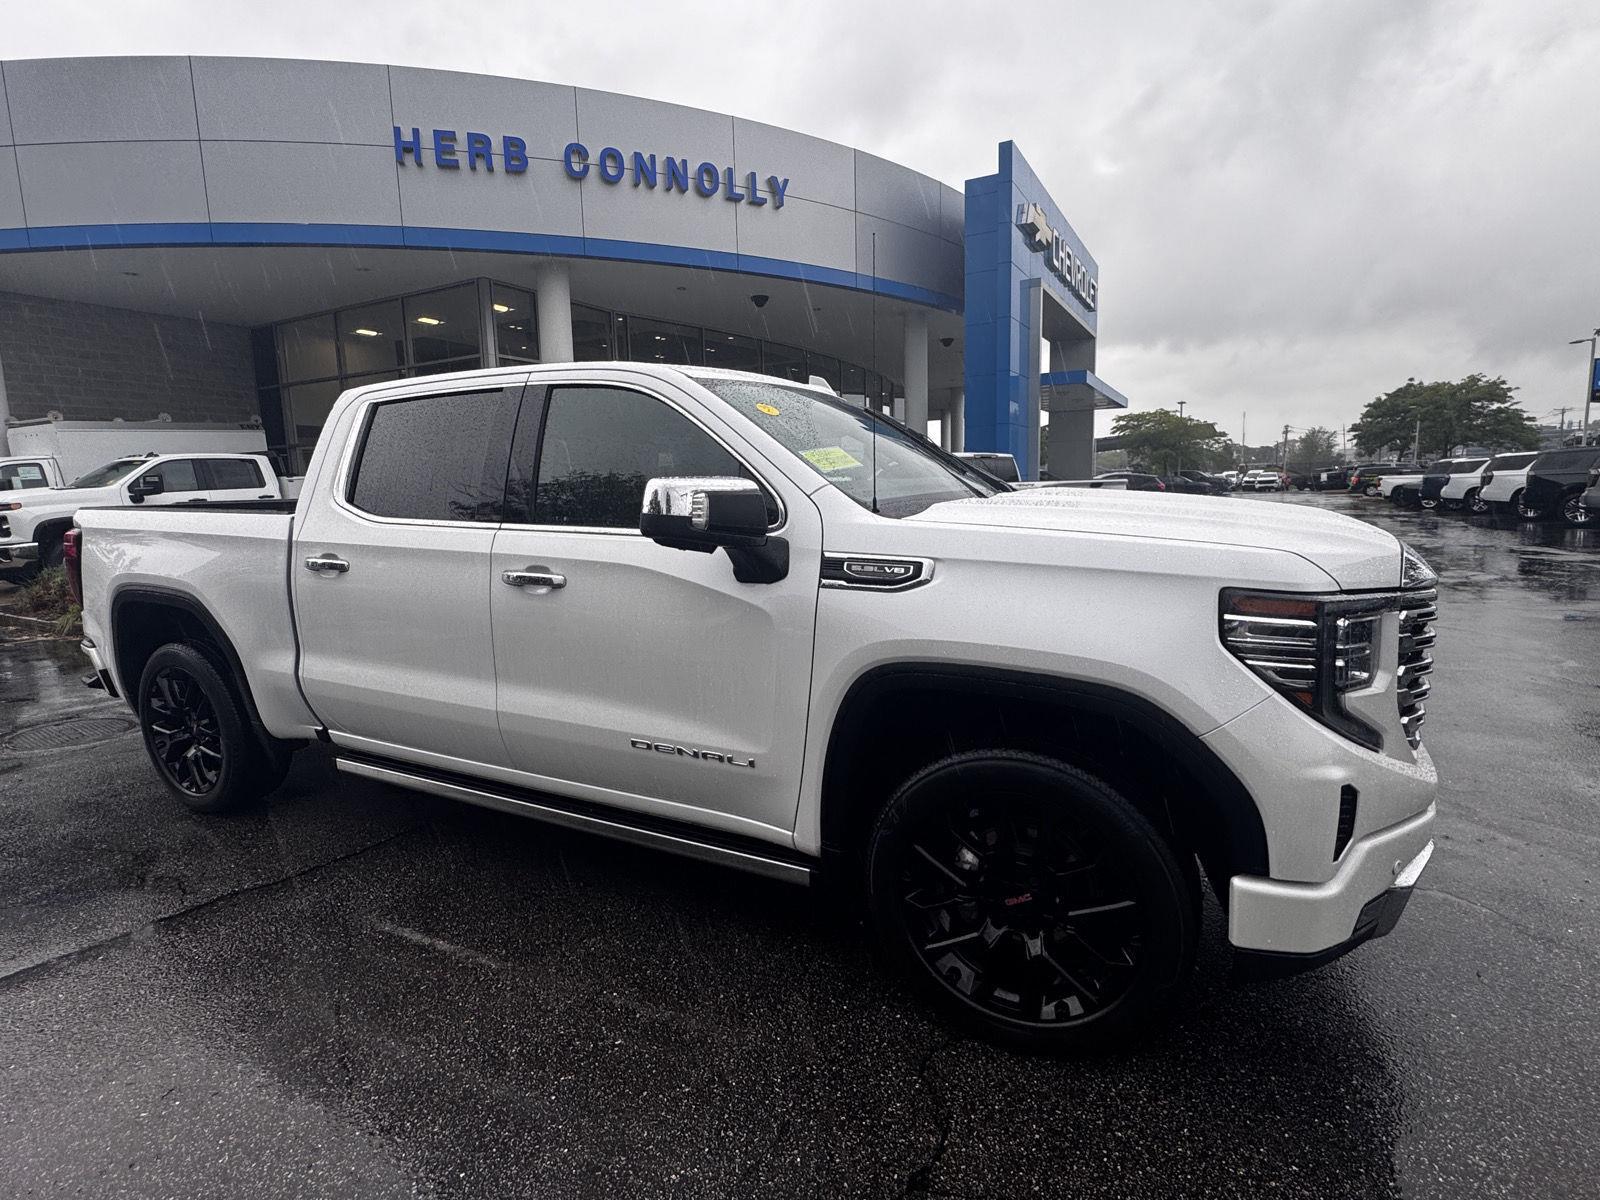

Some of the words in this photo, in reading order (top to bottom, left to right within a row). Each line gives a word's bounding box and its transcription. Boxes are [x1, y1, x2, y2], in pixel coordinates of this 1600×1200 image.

[393, 126, 529, 173] HERB
[564, 142, 790, 209] CONNOLLY
[630, 738, 756, 768] DENALI
[1004, 893, 1033, 906] GMC
